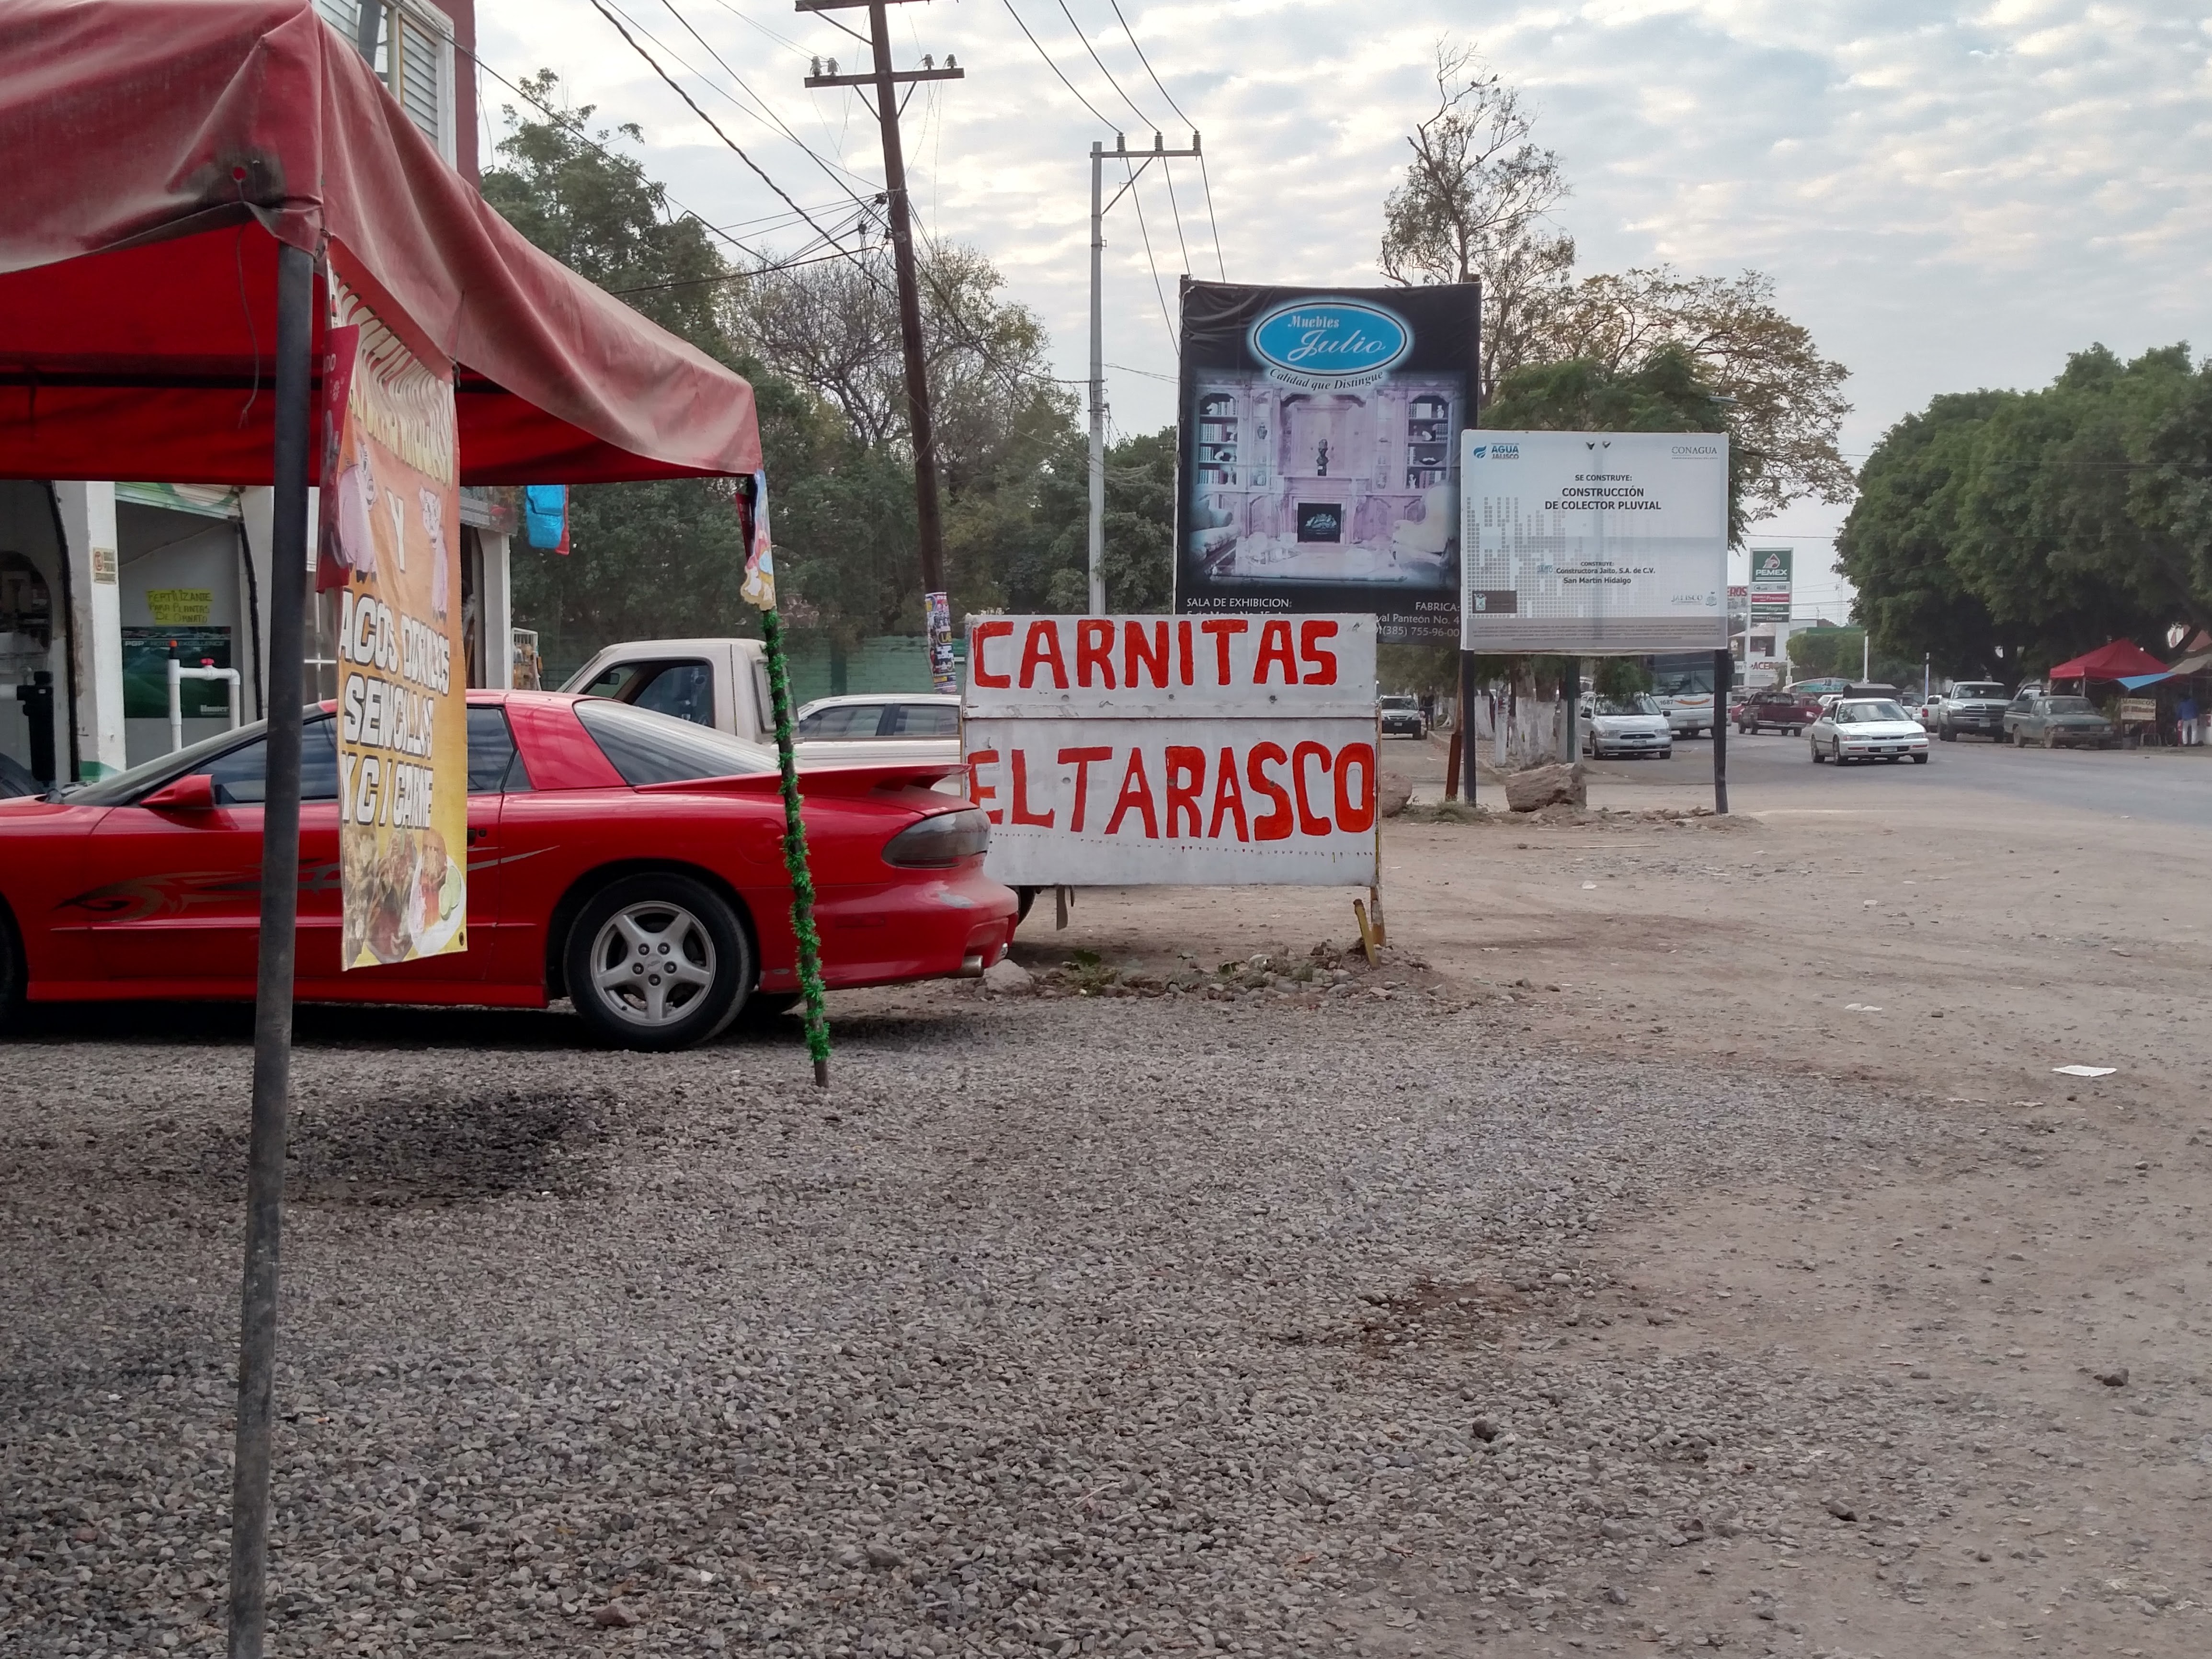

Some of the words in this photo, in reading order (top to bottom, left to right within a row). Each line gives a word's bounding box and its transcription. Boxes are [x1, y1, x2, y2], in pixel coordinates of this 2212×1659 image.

[1288, 316, 1339, 328] Muebles
[1288, 329, 1386, 361] Julio
[1269, 368, 1310, 387] Calidad
[1311, 380, 1331, 391] que
[1334, 371, 1383, 389] Distingue
[1562, 485, 1644, 497] CONSTRUCCIÓN
[1545, 501, 1558, 509] DE
[1562, 501, 1615, 510] COLECTOR
[1618, 501, 1662, 510] PLUVIAL
[385, 486, 406, 574] Y
[1187, 598, 1210, 607] SALA
[1214, 598, 1226, 606] DE
[1230, 598, 1292, 607] EXHIBICION:
[1415, 602, 1460, 612] FABRICA:
[1393, 614, 1430, 623] Panteón
[1433, 616, 1450, 625] No.
[1453, 616, 1460, 625] 4
[1411, 627, 1460, 637] 755-96-00
[972, 619, 1339, 690] CARNITAS
[341, 750, 358, 823] Y
[968, 749, 1055, 829] EL
[1057, 740, 1375, 843] TARASCO
